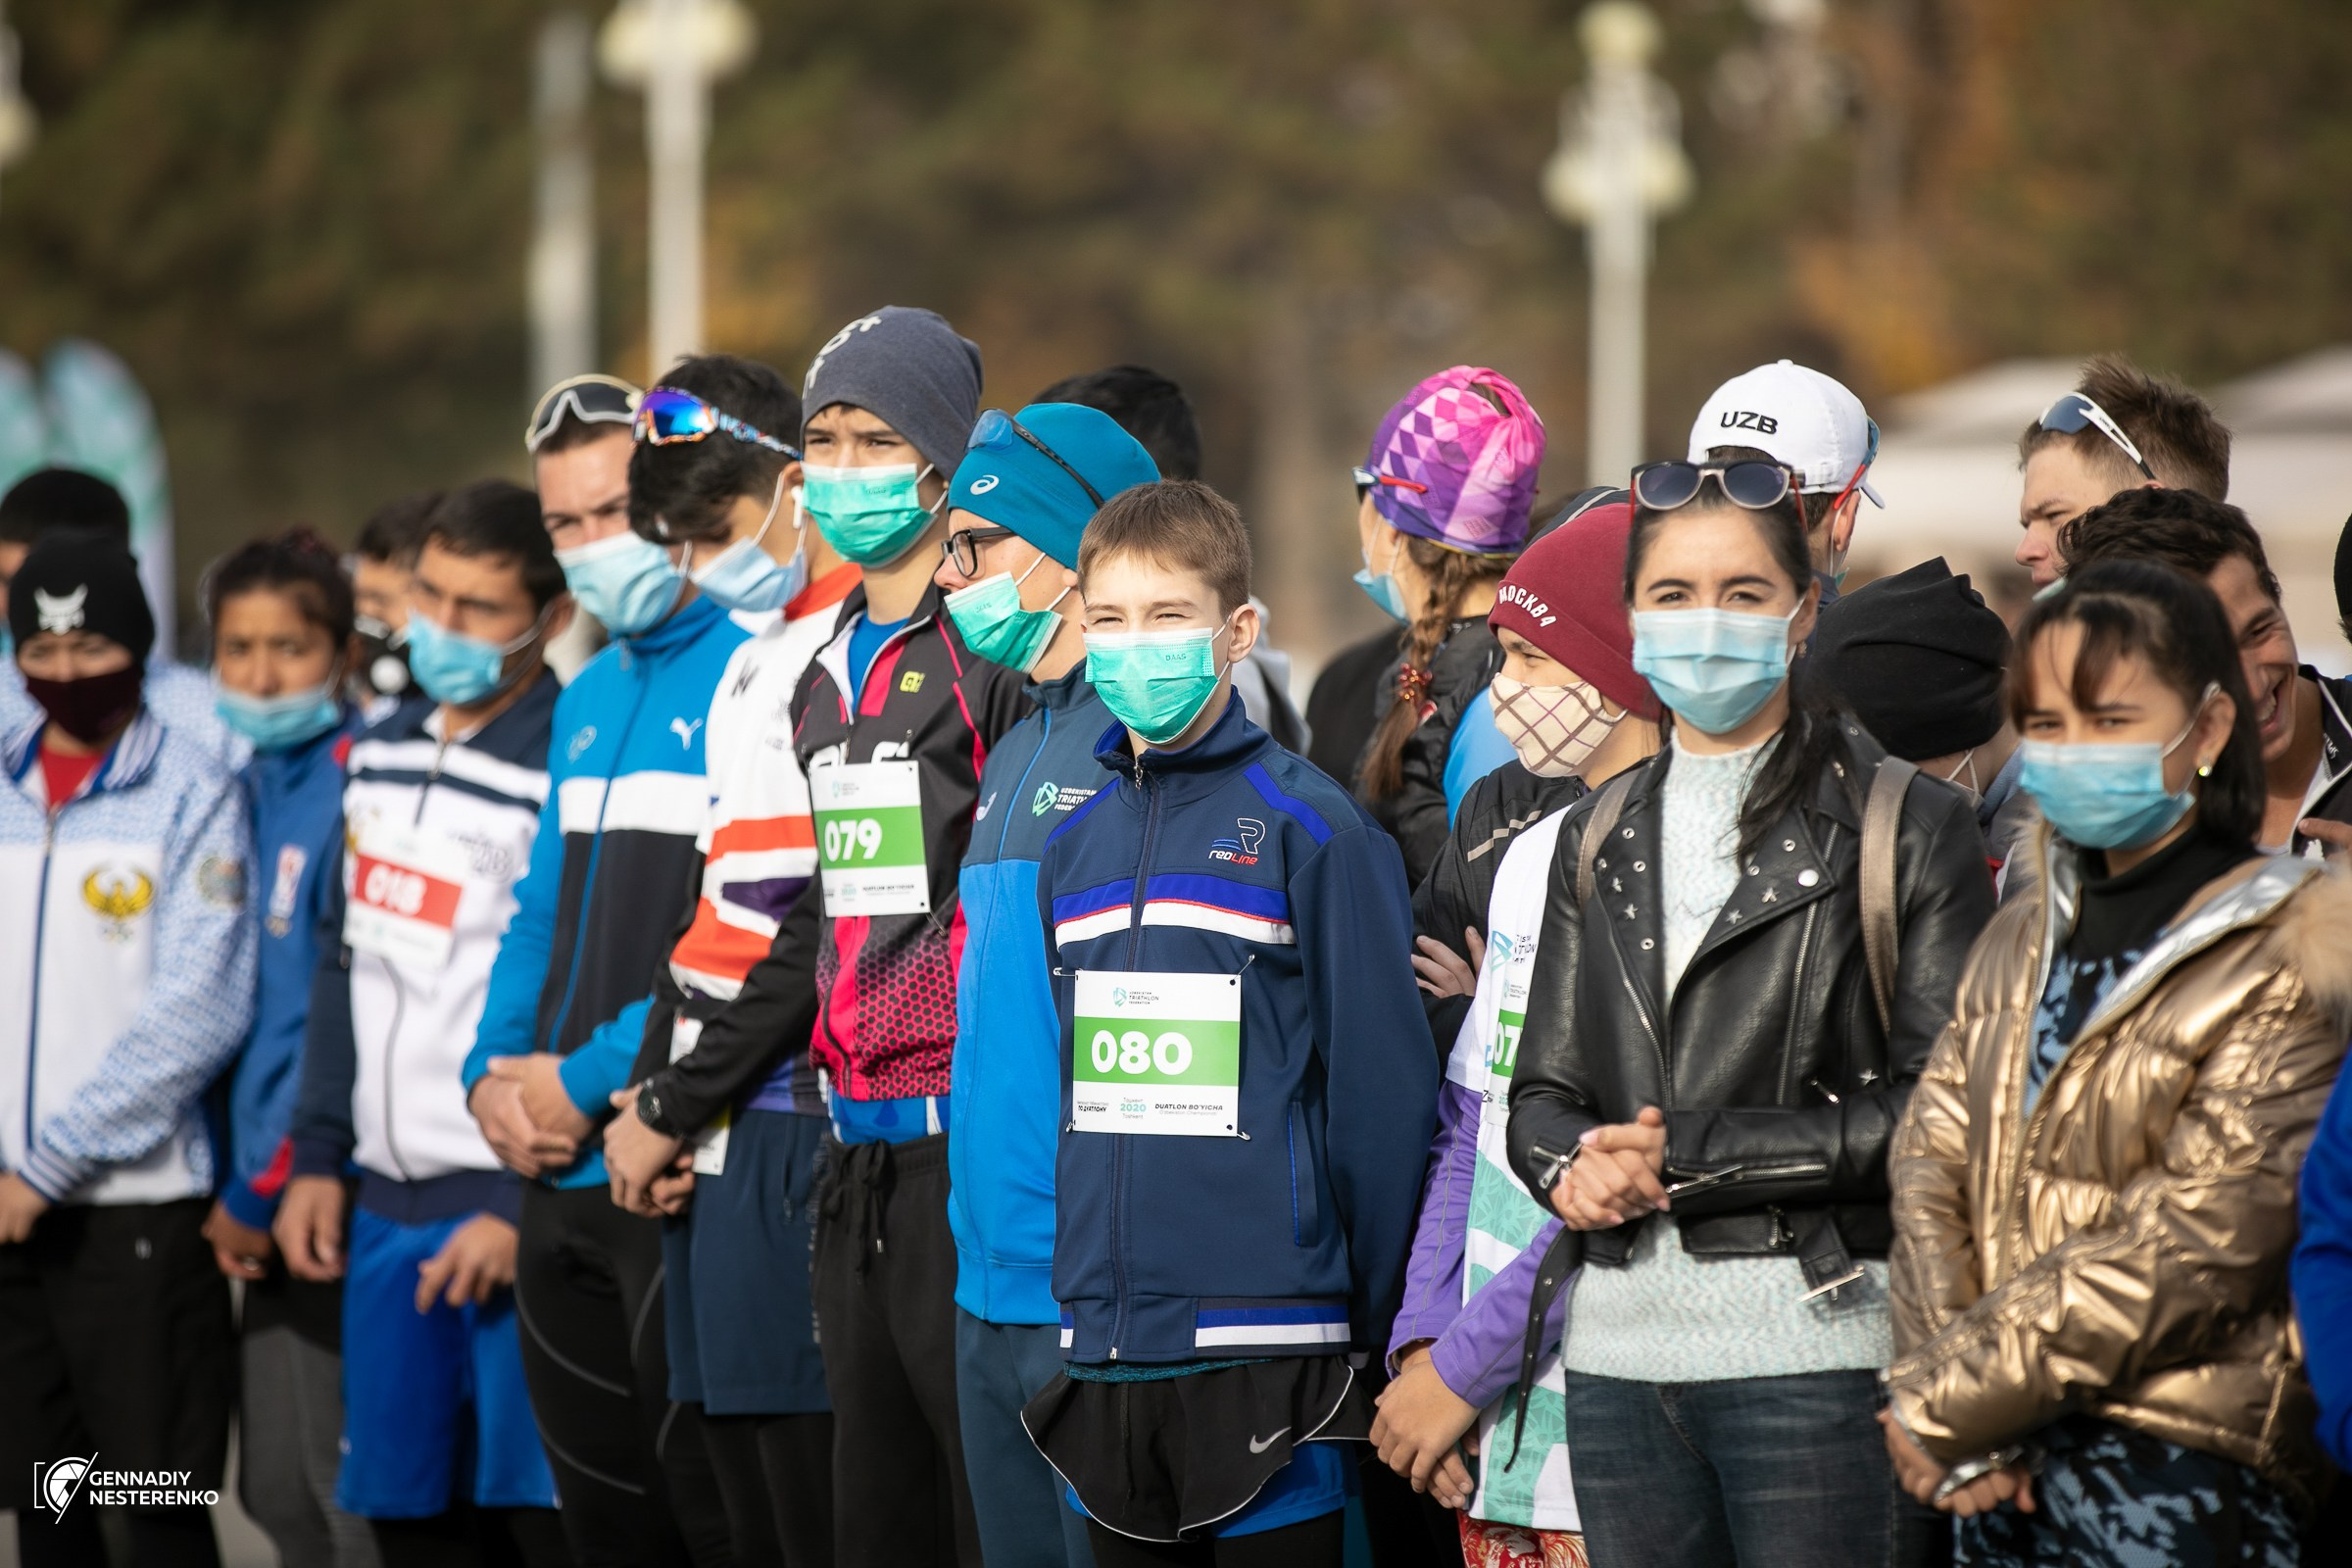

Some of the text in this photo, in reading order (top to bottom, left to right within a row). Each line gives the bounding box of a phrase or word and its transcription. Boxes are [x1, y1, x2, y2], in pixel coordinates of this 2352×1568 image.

[1720, 411, 1779, 435] UZB
[824, 817, 883, 863] 079
[1092, 1030, 1193, 1075] 080
[1120, 1102, 1147, 1112] 2020
